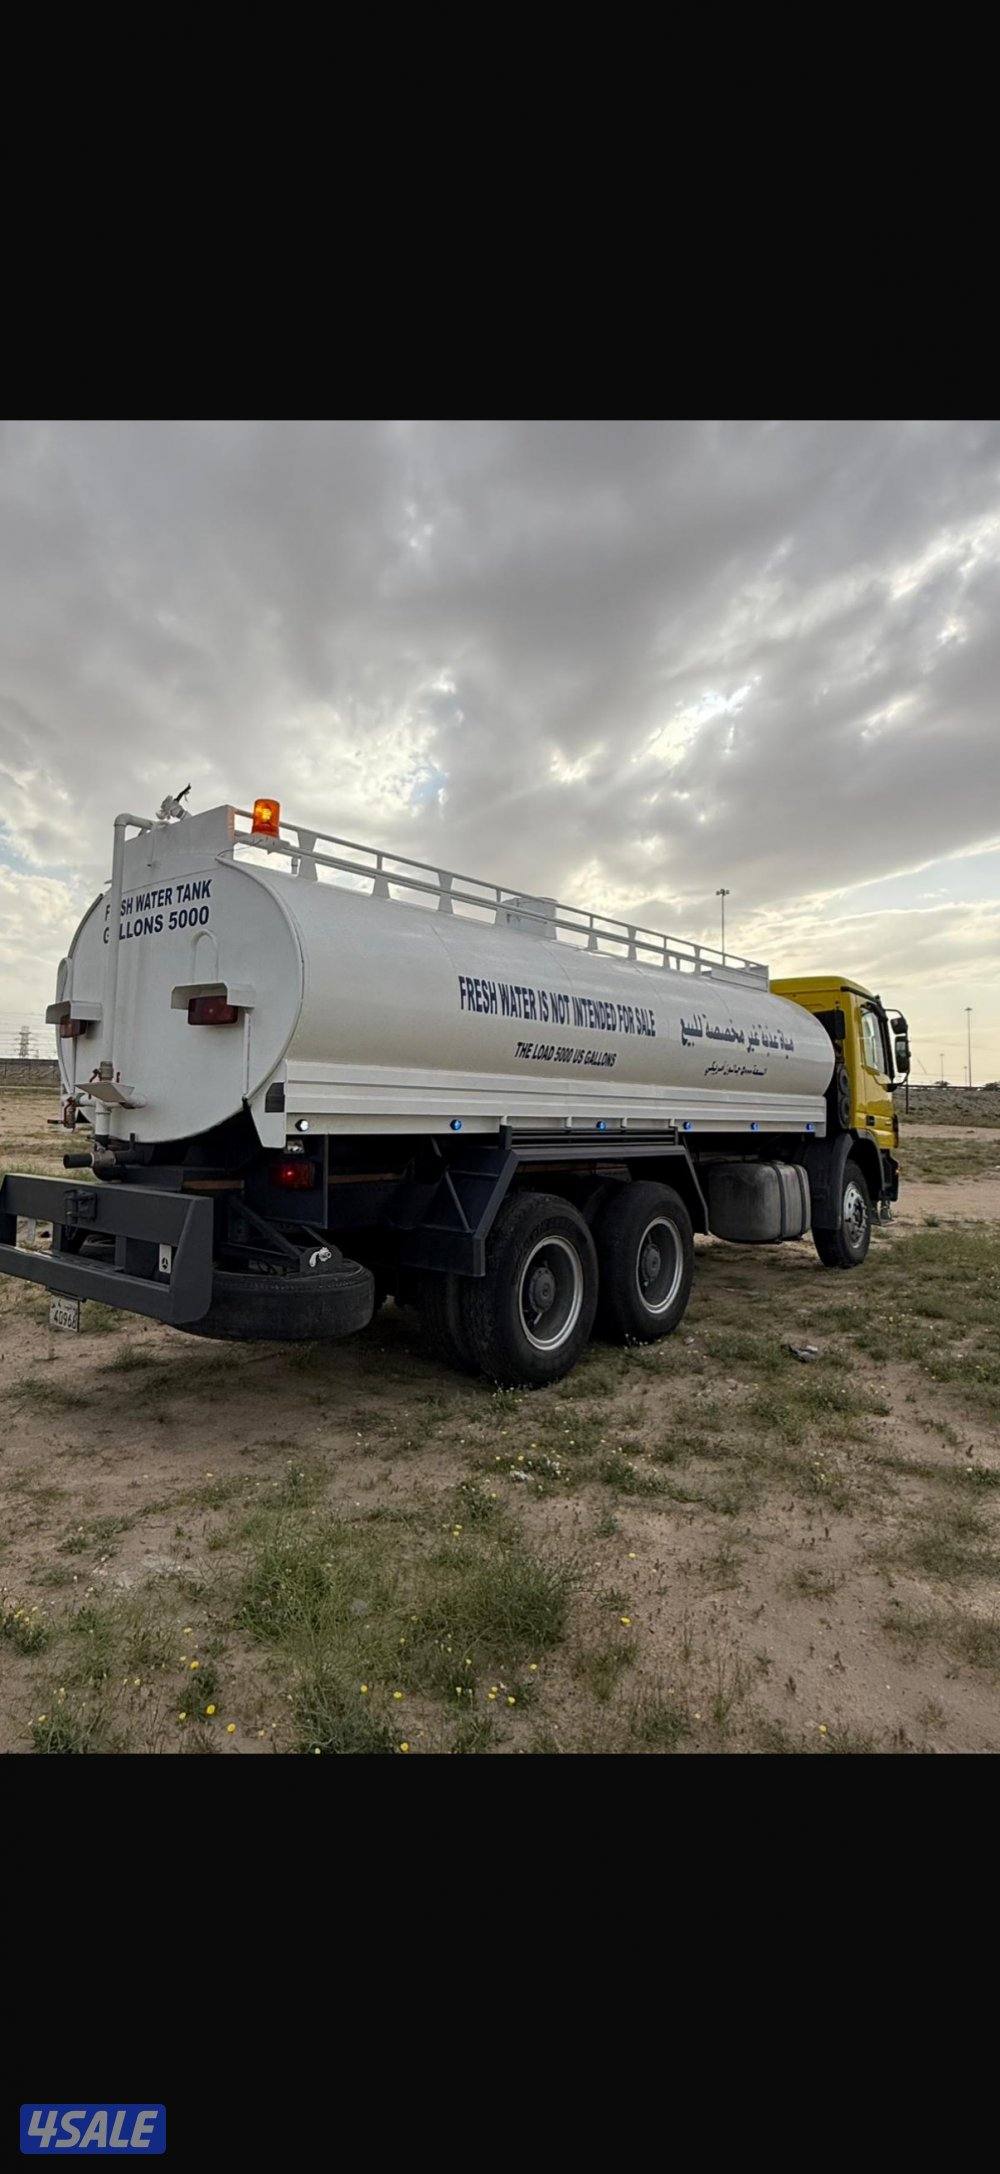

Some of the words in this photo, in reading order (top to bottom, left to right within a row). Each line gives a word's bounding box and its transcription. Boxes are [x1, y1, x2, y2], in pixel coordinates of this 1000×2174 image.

[105, 897, 133, 921] FSH
[136, 888, 173, 913] WATER
[177, 879, 213, 903] TANK
[103, 914, 164, 944] GLLONS
[168, 905, 210, 931] 5000
[458, 976, 498, 1014] FRESH
[499, 983, 537, 1021] WATER
[538, 990, 549, 1023] IS
[550, 992, 571, 1025] NOT
[572, 996, 617, 1032] INTENDED
[617, 1004, 636, 1034] FOR
[636, 1007, 656, 1037] SALE
[680, 1013, 704, 1047] للبيع
[514, 1041, 531, 1058] THE
[532, 1043, 555, 1061] LOAD
[555, 1047, 574, 1063] 5000
[573, 1049, 584, 1064] US
[584, 1050, 617, 1067] GALLONS
